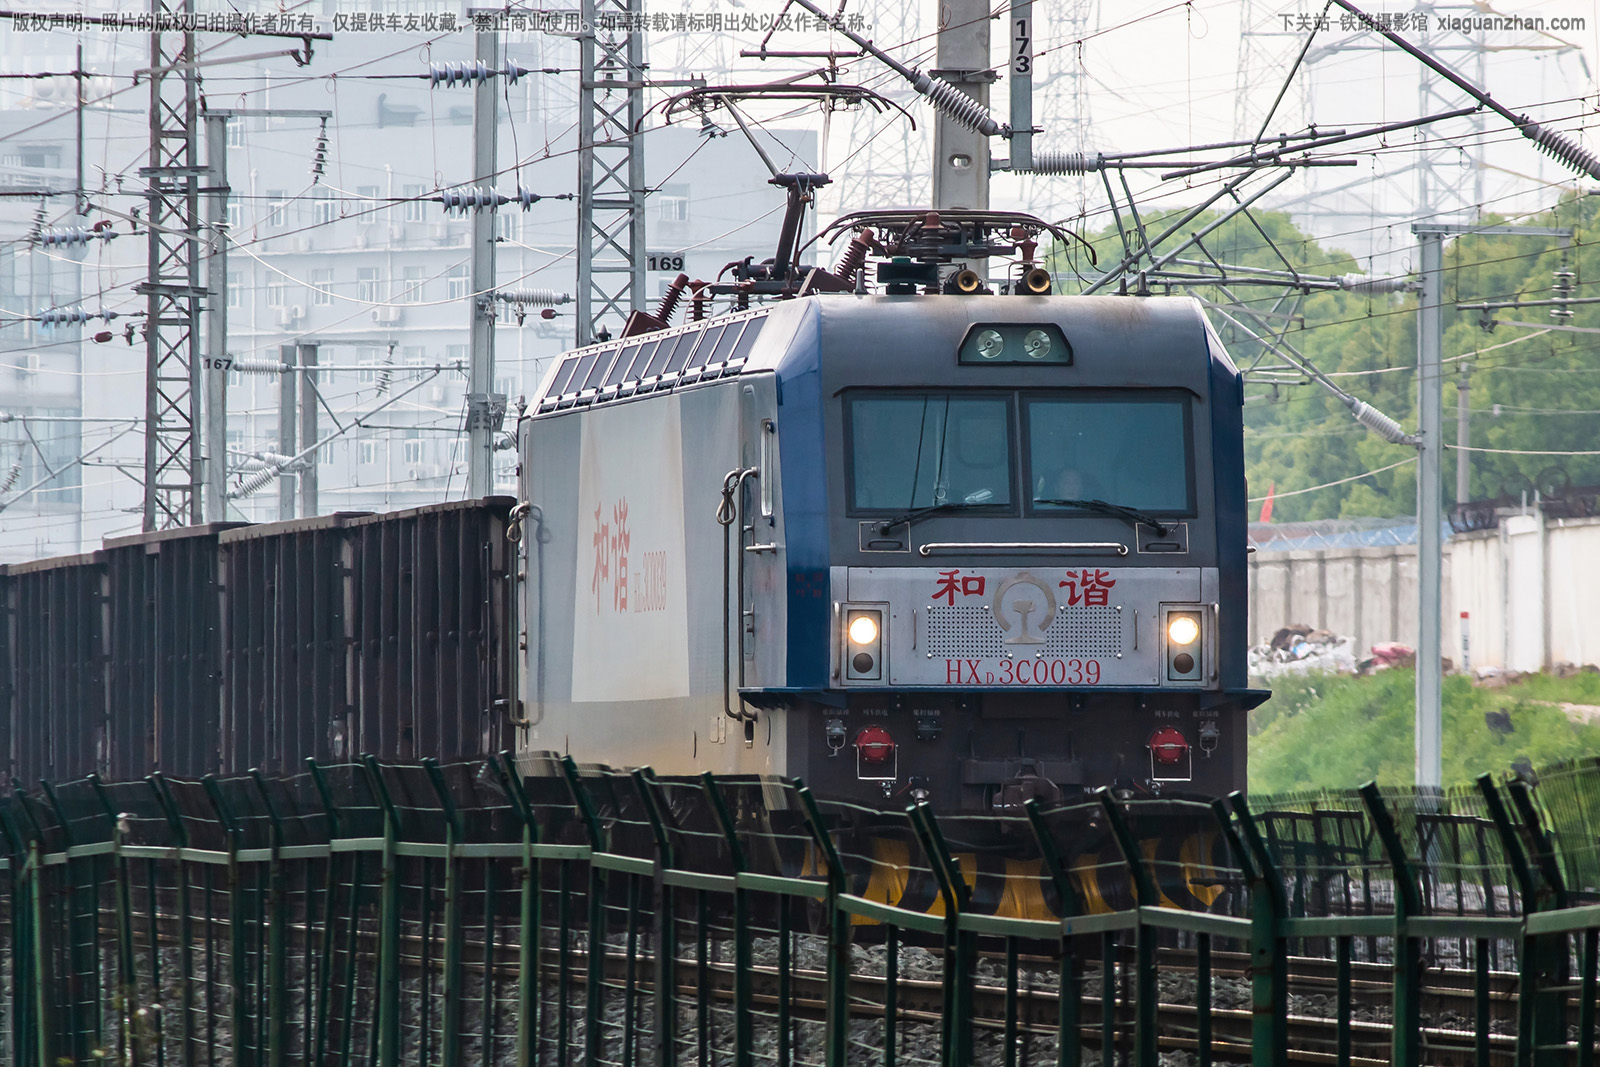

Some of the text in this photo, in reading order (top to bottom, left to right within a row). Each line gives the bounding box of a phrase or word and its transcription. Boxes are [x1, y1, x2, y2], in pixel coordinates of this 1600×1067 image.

[1015, 19, 1030, 73] 173
[649, 256, 683, 271] 169
[205, 358, 232, 371] 167
[592, 495, 631, 616] 和谐
[931, 568, 1117, 607] 和 谐
